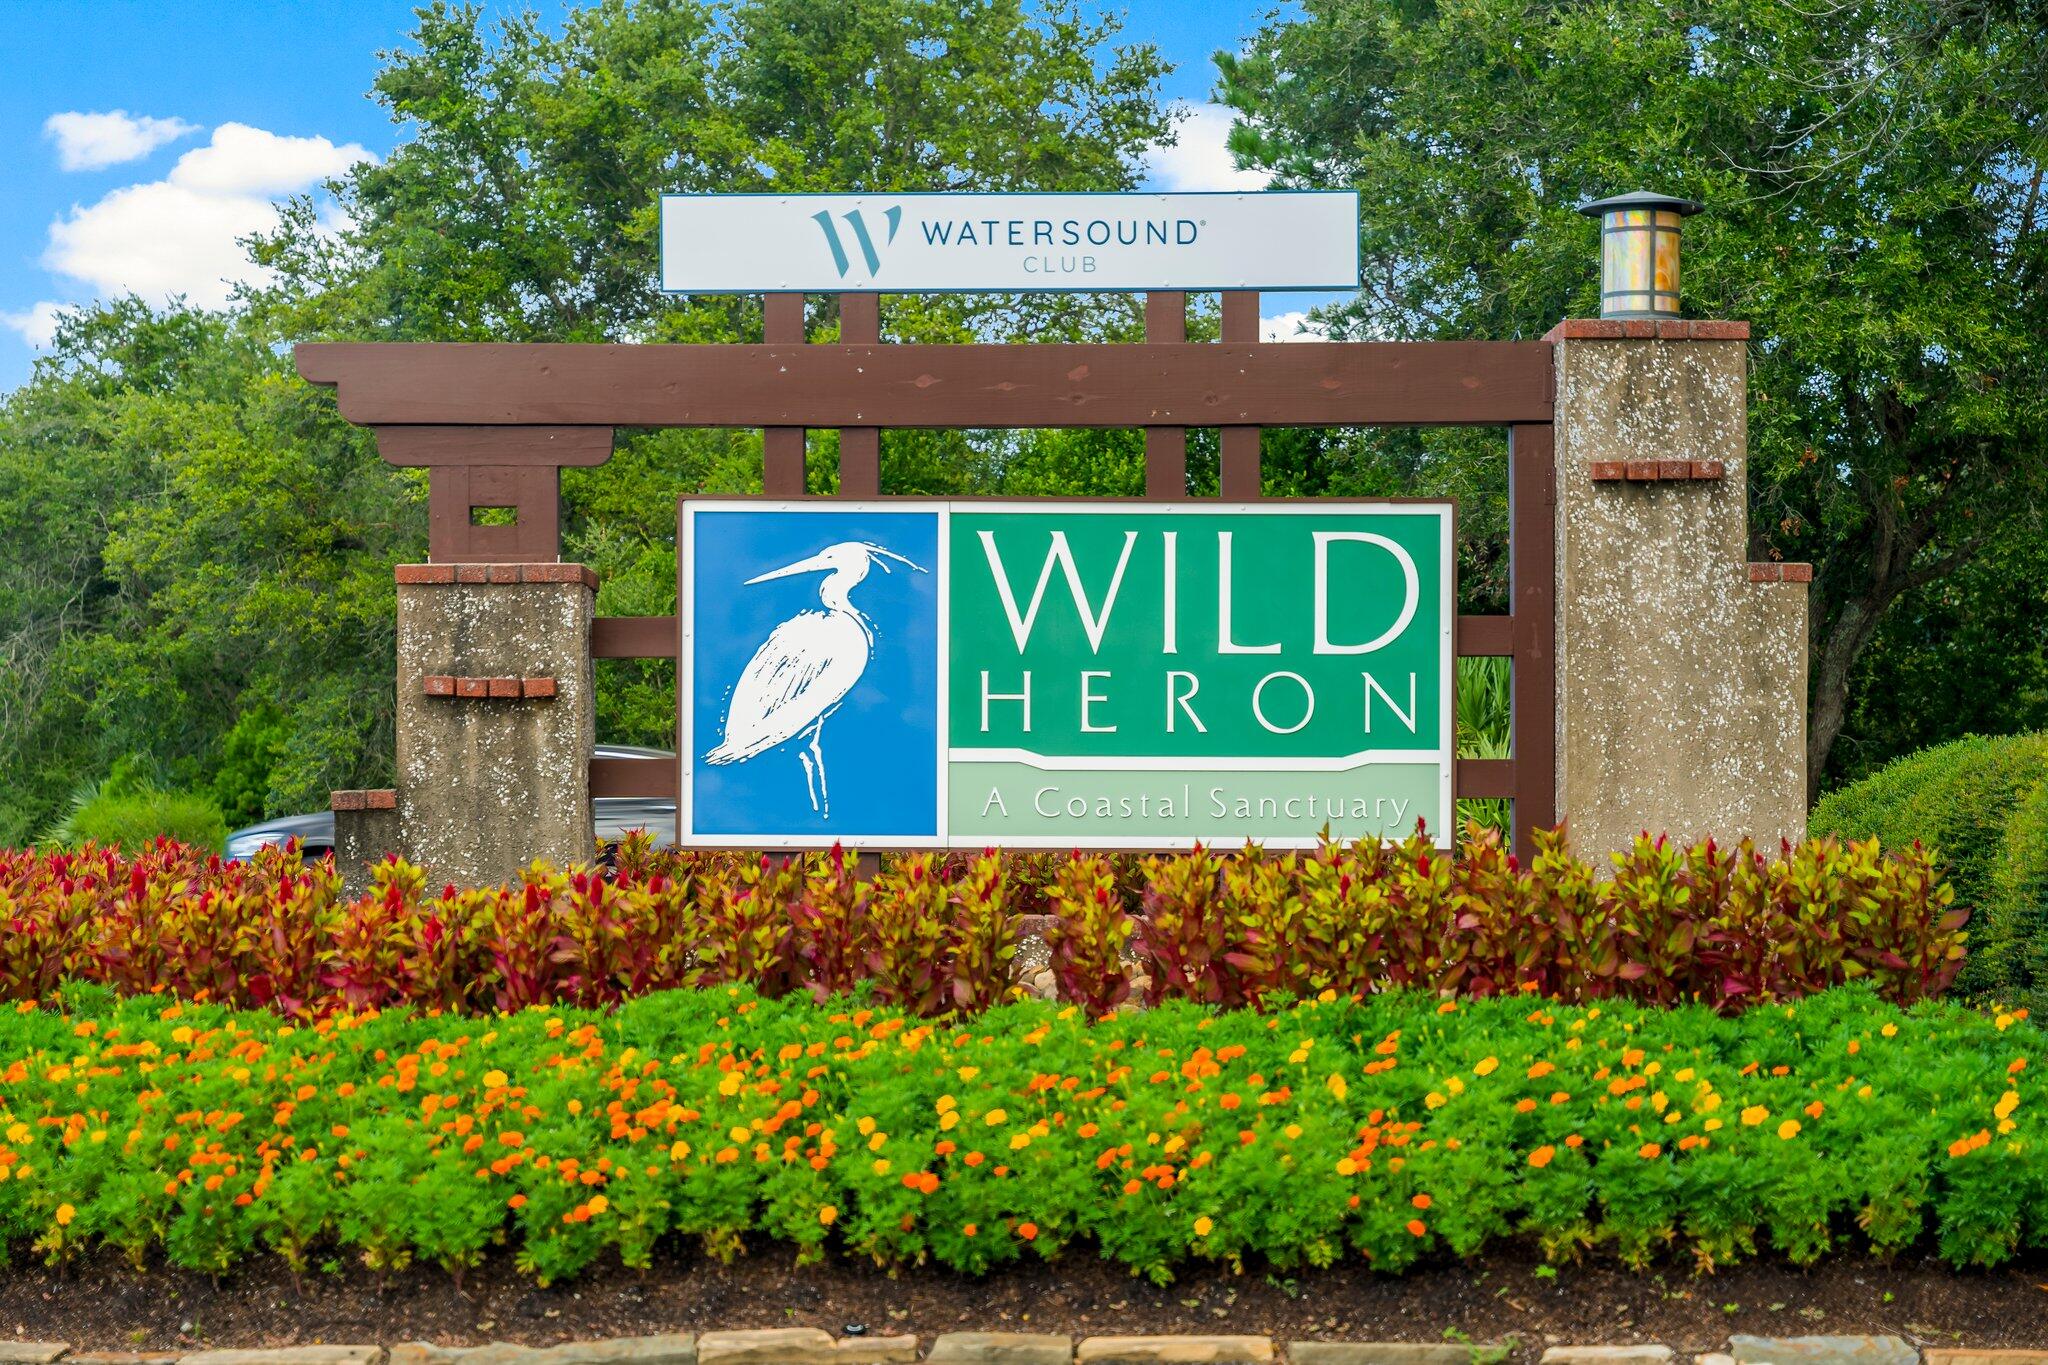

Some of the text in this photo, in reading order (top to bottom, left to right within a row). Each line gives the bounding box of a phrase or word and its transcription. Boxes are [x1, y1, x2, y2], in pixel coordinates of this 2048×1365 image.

[1023, 256, 1097, 273] CLUB
[977, 530, 1420, 655] WILD
[979, 670, 1418, 734] HERON
[982, 786, 1411, 827] A Coastal Sanctuary
